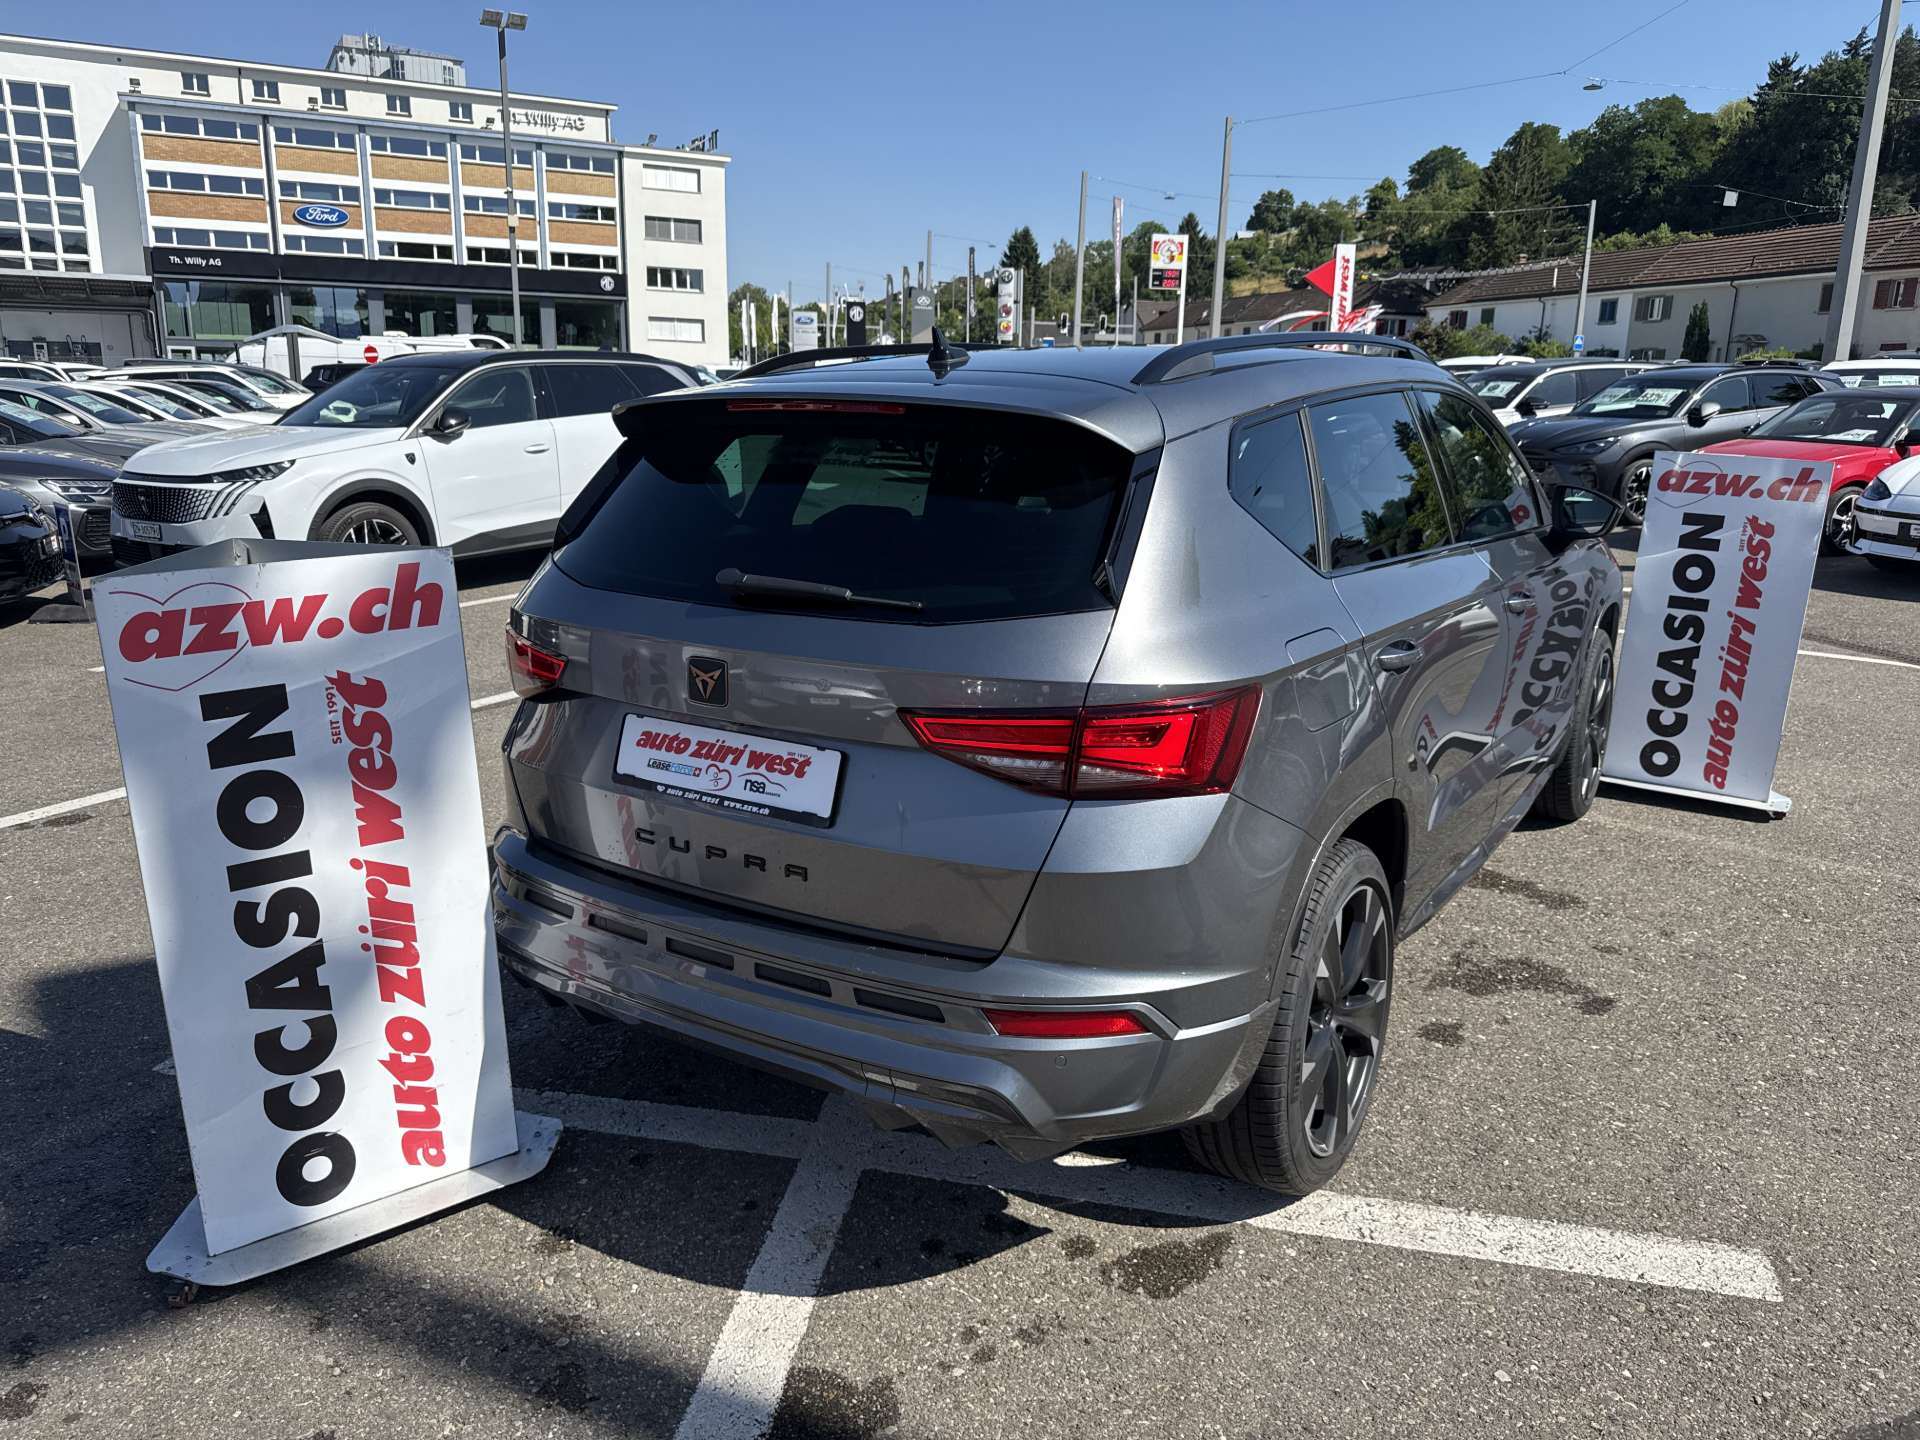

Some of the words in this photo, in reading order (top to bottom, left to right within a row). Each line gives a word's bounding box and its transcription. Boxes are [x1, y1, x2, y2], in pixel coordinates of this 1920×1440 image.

[525, 110, 560, 132] Willy
[561, 114, 586, 132] AG
[168, 255, 183, 265] Th.
[185, 256, 207, 267] Willy
[208, 258, 222, 266] AG
[849, 306, 864, 322] MG
[1656, 467, 1823, 503] azw.ch
[1735, 514, 1775, 610] west
[118, 561, 444, 663] azw.ch
[1639, 512, 1725, 778] OCCASION
[1718, 610, 1757, 702] züri
[325, 686, 338, 715] 1991
[324, 670, 405, 847] west
[329, 719, 343, 745] SEIT
[636, 730, 691, 755] auto
[689, 738, 748, 766] züri
[746, 750, 812, 779] west
[1703, 699, 1740, 790] auto
[702, 794, 719, 804] west
[744, 779, 766, 794] nsa
[634, 828, 808, 882] CUPRA
[198, 683, 356, 1207] OCCASION
[349, 857, 427, 1008] züri
[378, 1015, 446, 1168] auto
